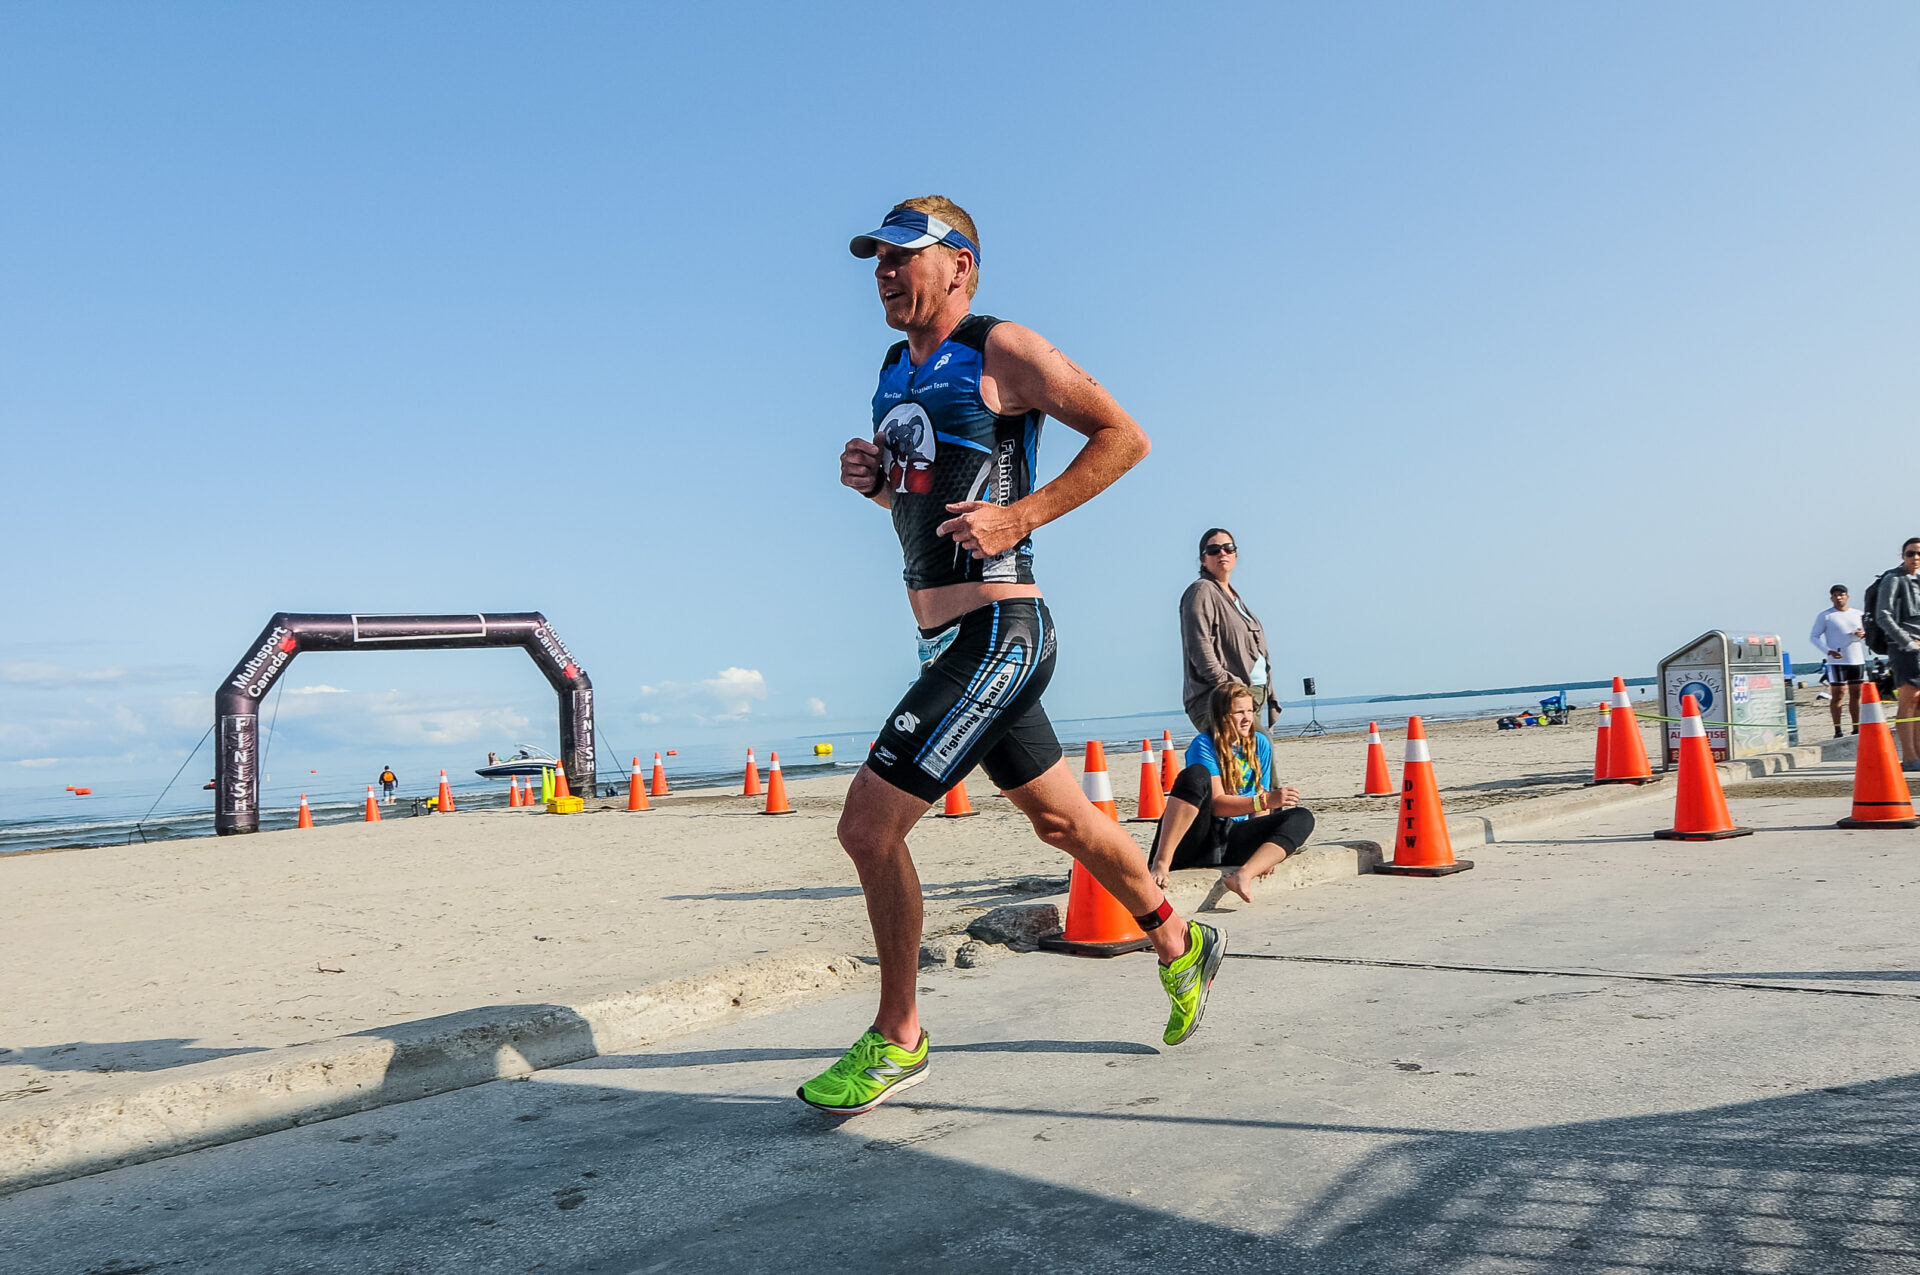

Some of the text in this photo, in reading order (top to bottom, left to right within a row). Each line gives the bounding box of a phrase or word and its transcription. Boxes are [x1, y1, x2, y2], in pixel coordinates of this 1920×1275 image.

[232, 626, 287, 689] Multisport
[247, 651, 288, 698] Canada
[534, 627, 568, 669] Canada
[939, 673, 1009, 757] Fighting Koalas
[1667, 674, 1693, 696] PARK
[1697, 671, 1722, 694] SIGN
[583, 691, 595, 772] FINISH
[1670, 730, 1726, 739] ATISE
[234, 717, 248, 811] FINISH
[1404, 779, 1416, 848] DTTW
